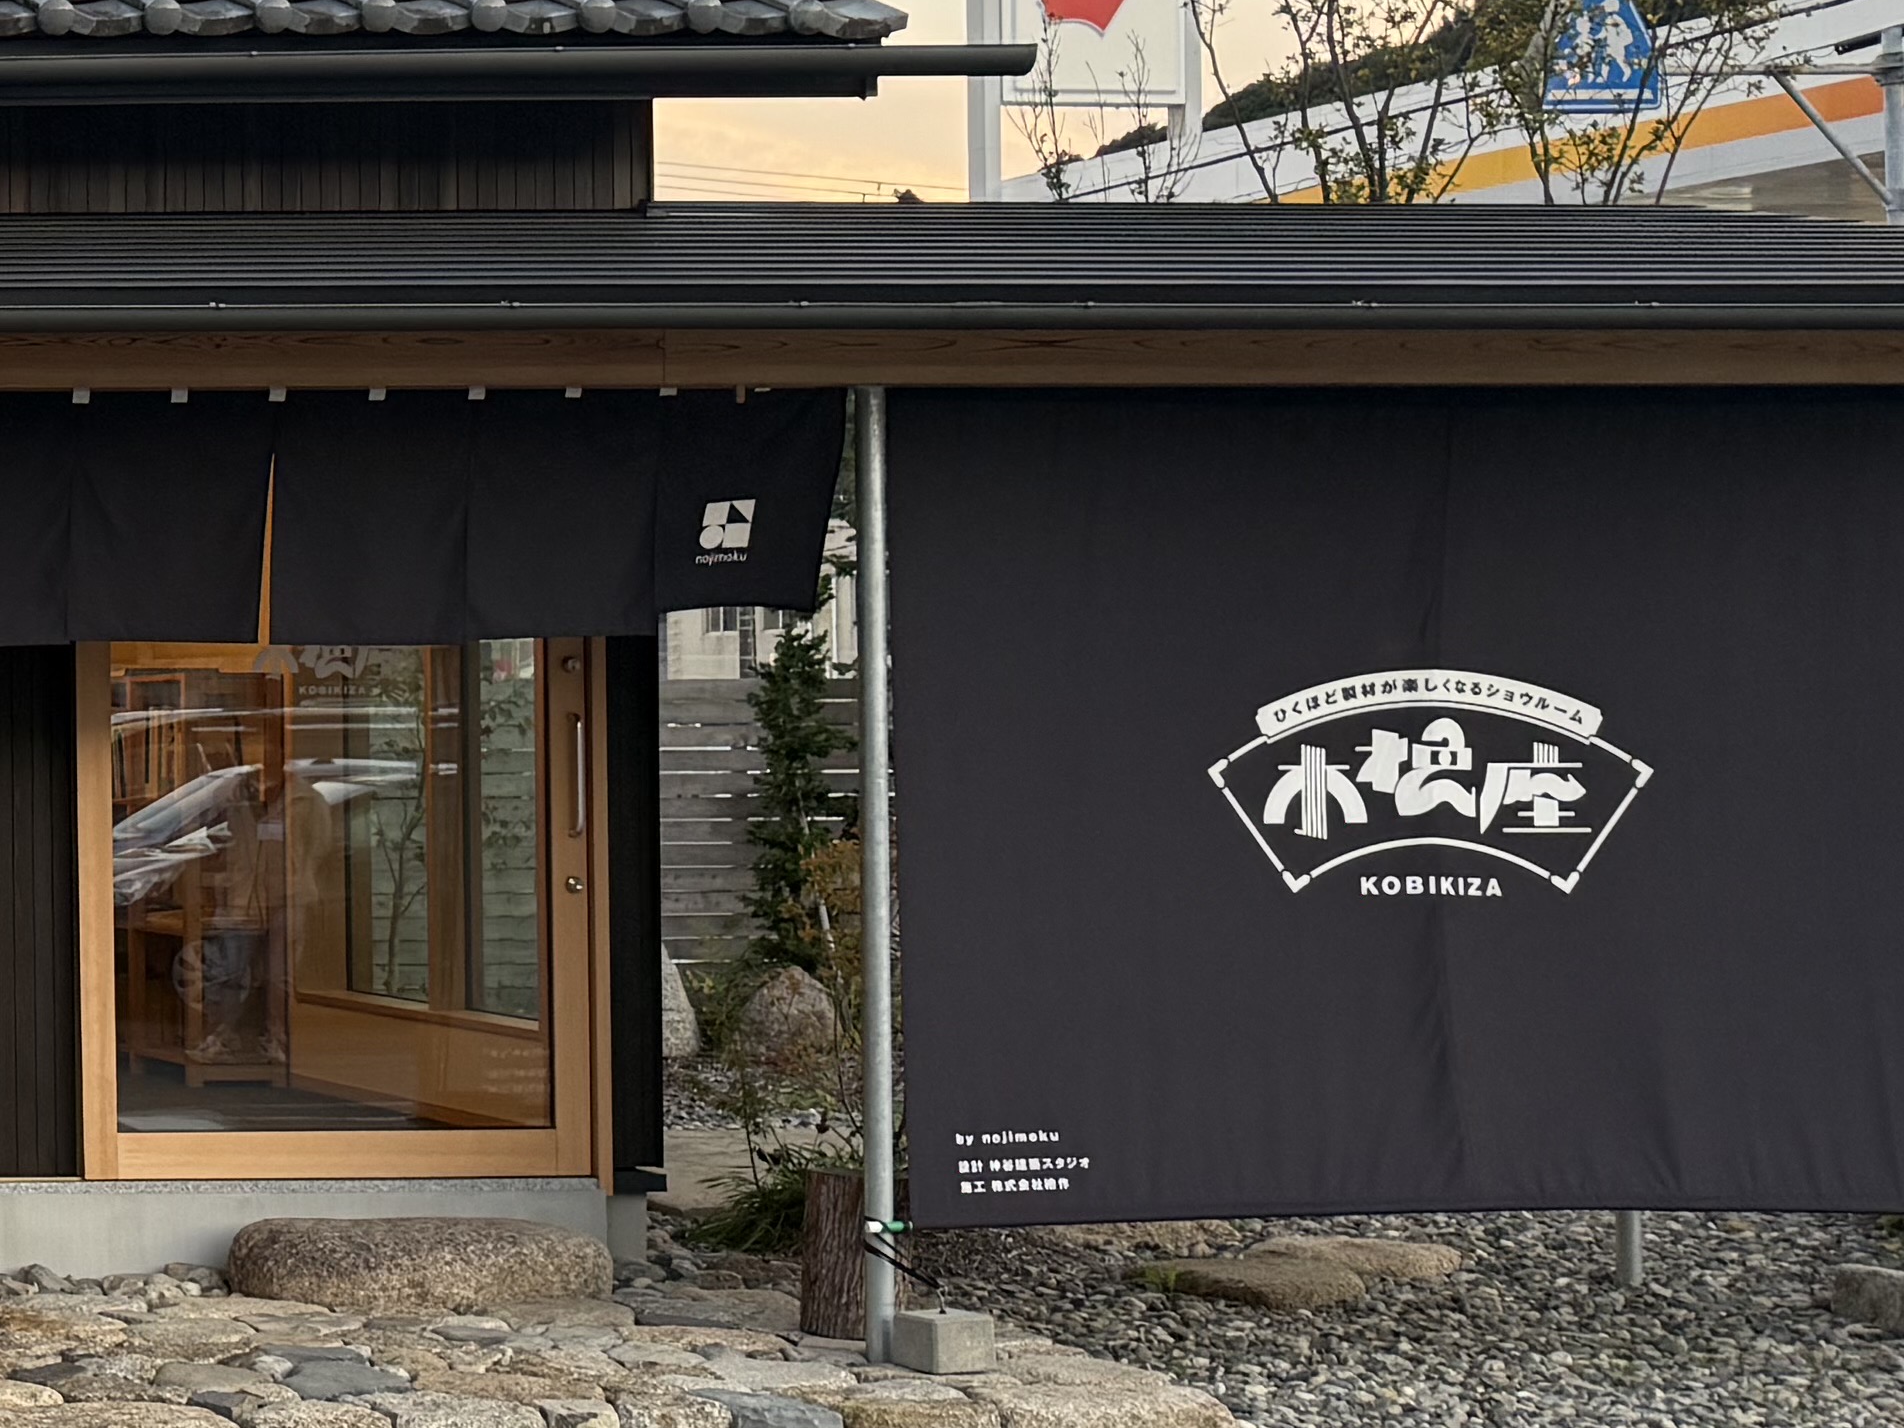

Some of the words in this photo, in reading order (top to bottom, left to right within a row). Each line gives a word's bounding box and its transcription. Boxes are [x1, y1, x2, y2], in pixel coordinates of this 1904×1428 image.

[695, 551, 747, 566] nojimoku
[298, 685, 367, 695] KOBIKIZA
[1360, 875, 1503, 897] KOBIKIZA
[955, 1133, 974, 1146] by
[981, 1130, 1059, 1145] nojimoku
